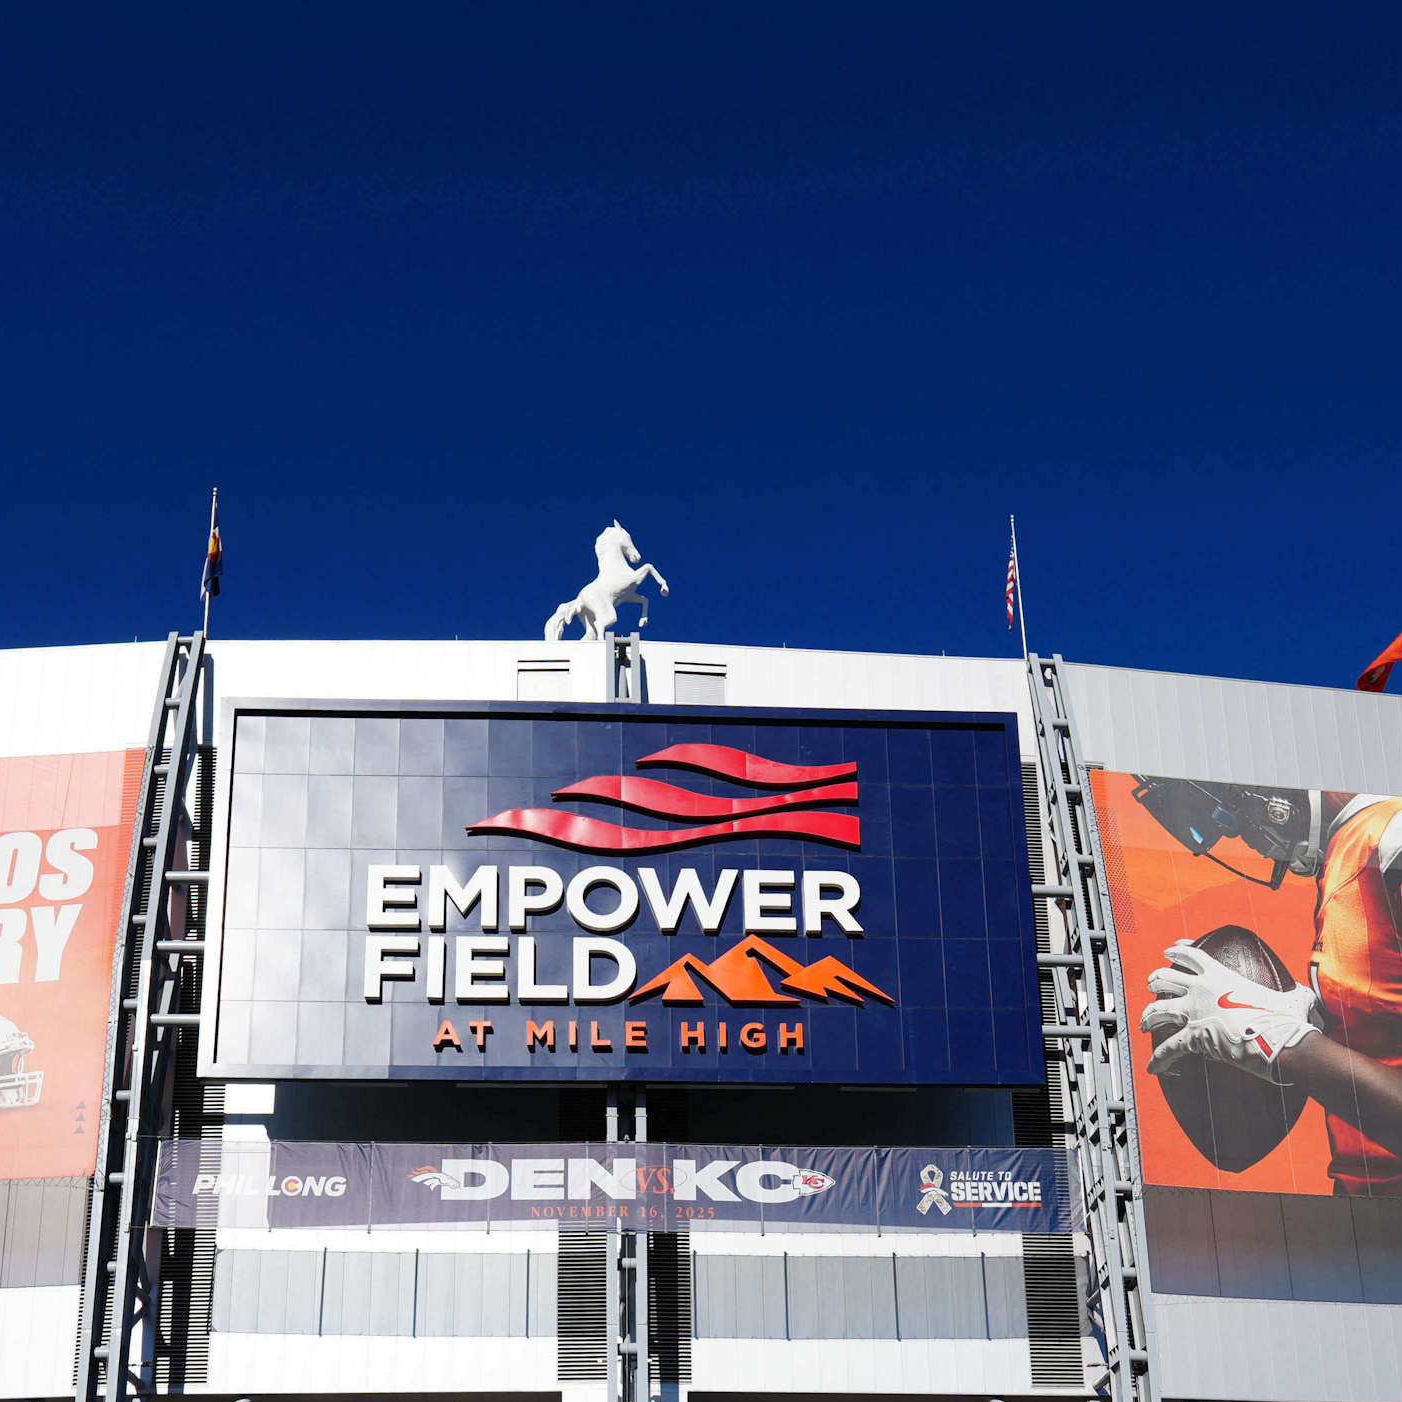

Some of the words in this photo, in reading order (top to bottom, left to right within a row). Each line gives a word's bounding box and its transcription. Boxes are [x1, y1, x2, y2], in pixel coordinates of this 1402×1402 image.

[367, 865, 863, 936] EMPOWER
[364, 935, 638, 1004] FIELD
[432, 1020, 493, 1053] AT
[526, 1020, 648, 1053] MILE
[681, 1021, 804, 1054] HIGH
[193, 1175, 260, 1196] PHIL
[268, 1175, 347, 1197] LONG
[441, 1158, 636, 1201] DEN
[636, 1165, 675, 1194] VS.
[673, 1159, 799, 1204] KC
[950, 1171, 995, 1182] SALUTE
[997, 1171, 1012, 1182] TO
[950, 1182, 1042, 1202] SERVICE
[531, 1205, 628, 1219] NOVEMBER
[640, 1206, 667, 1220] 16,
[676, 1206, 716, 1220] 2025
